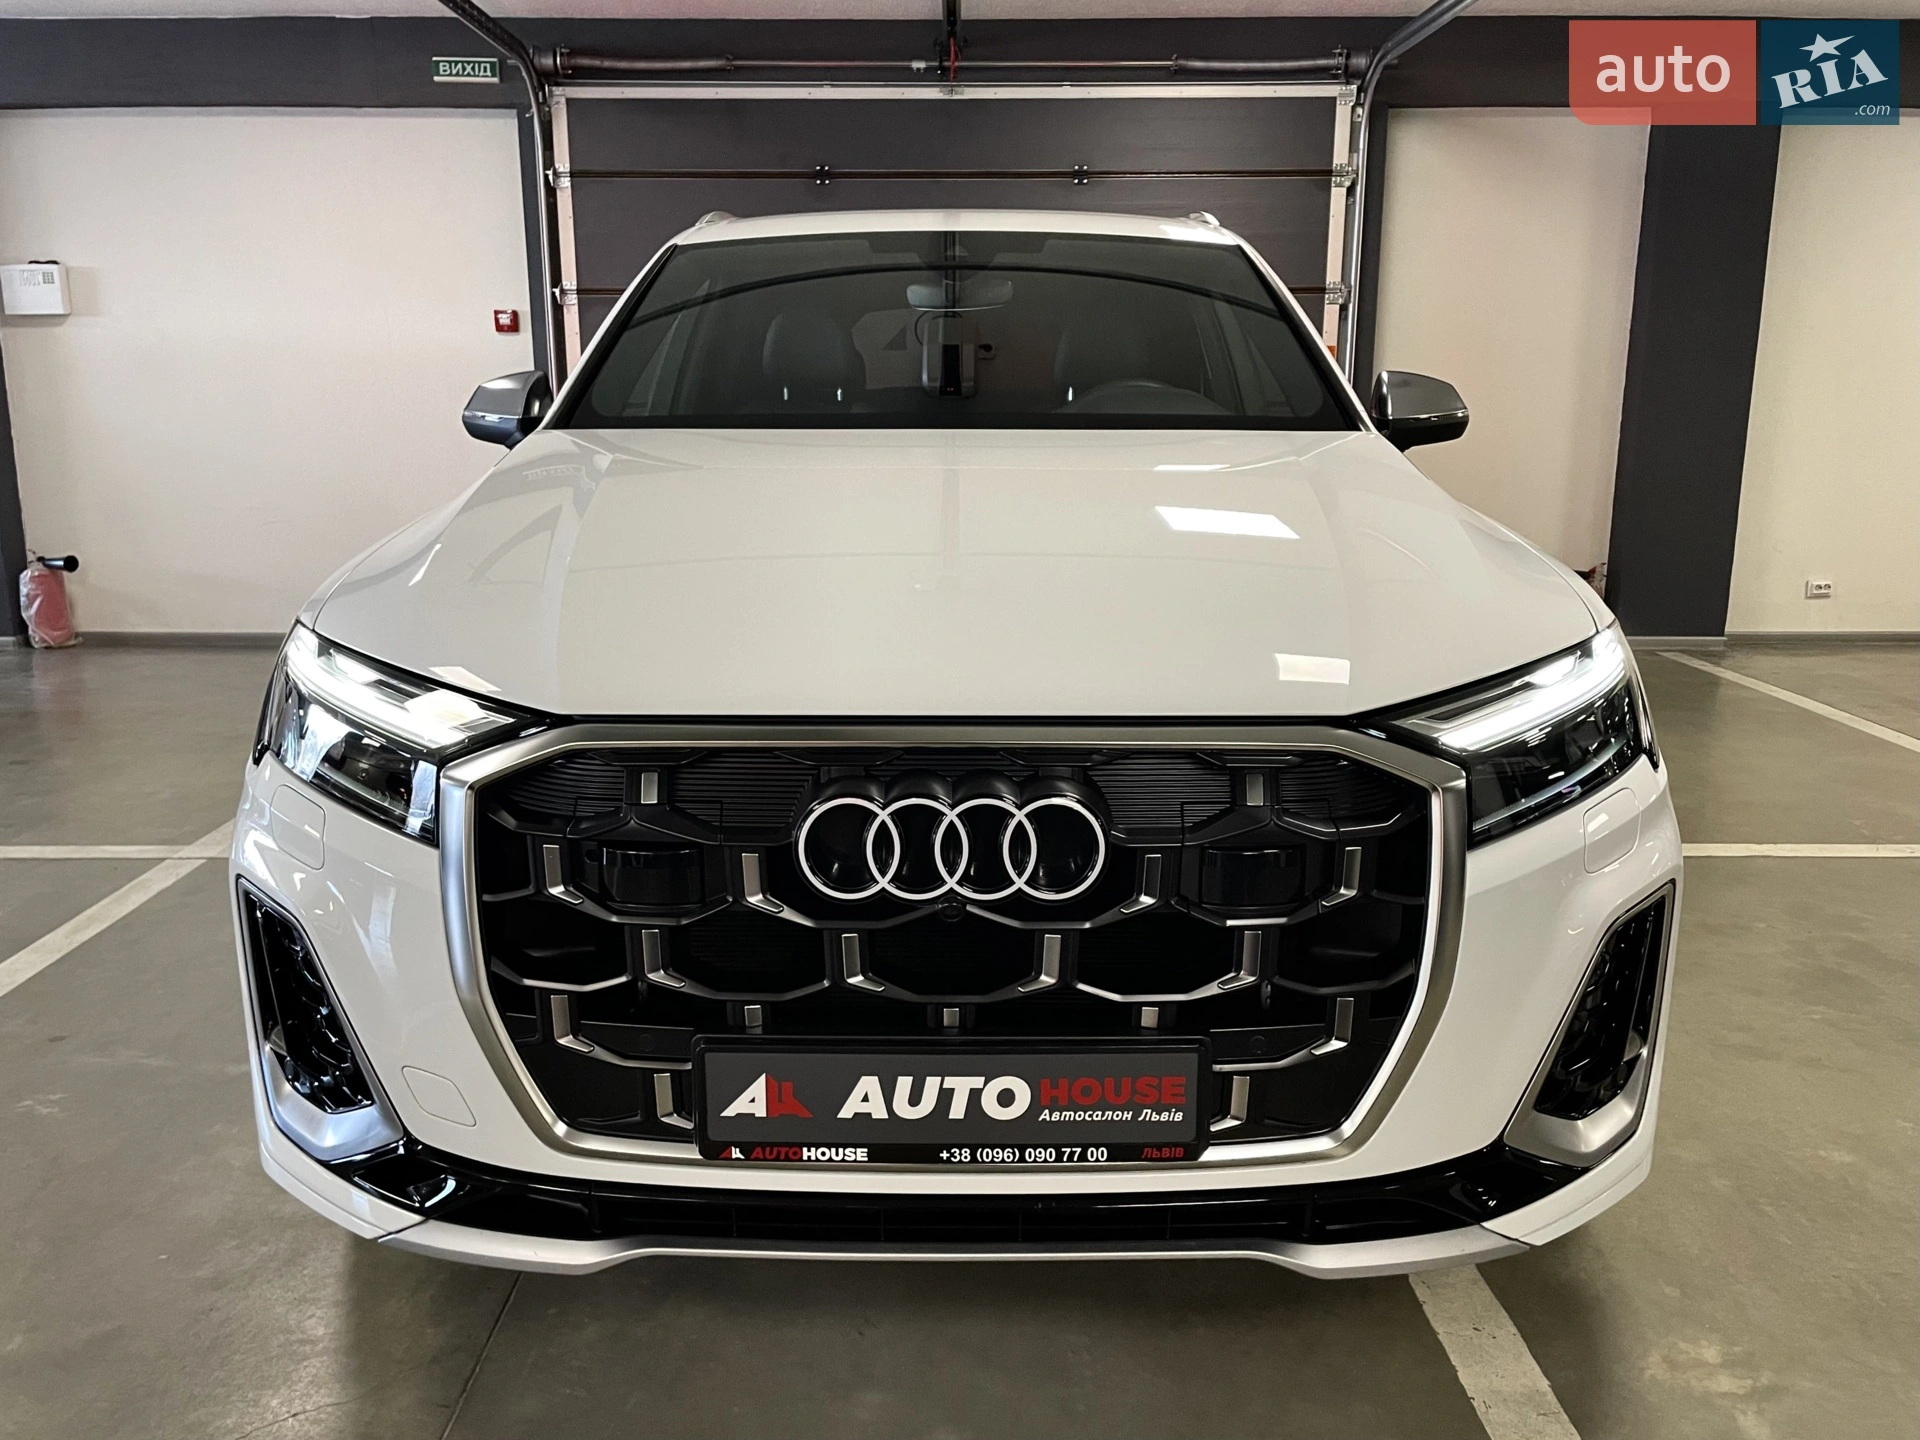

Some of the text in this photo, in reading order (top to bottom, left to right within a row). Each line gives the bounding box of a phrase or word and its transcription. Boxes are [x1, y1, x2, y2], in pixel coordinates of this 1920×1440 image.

[439, 62, 491, 77] ВИХІД
[836, 1075, 1186, 1120] AUTO HOUSE
[1038, 1108, 1184, 1122] Автосалон Львів
[750, 1147, 868, 1161] AUTOHOUSE
[939, 1147, 1107, 1163] +38 (096) 090 77 00
[1142, 1147, 1184, 1159] ЛЬВІВ
